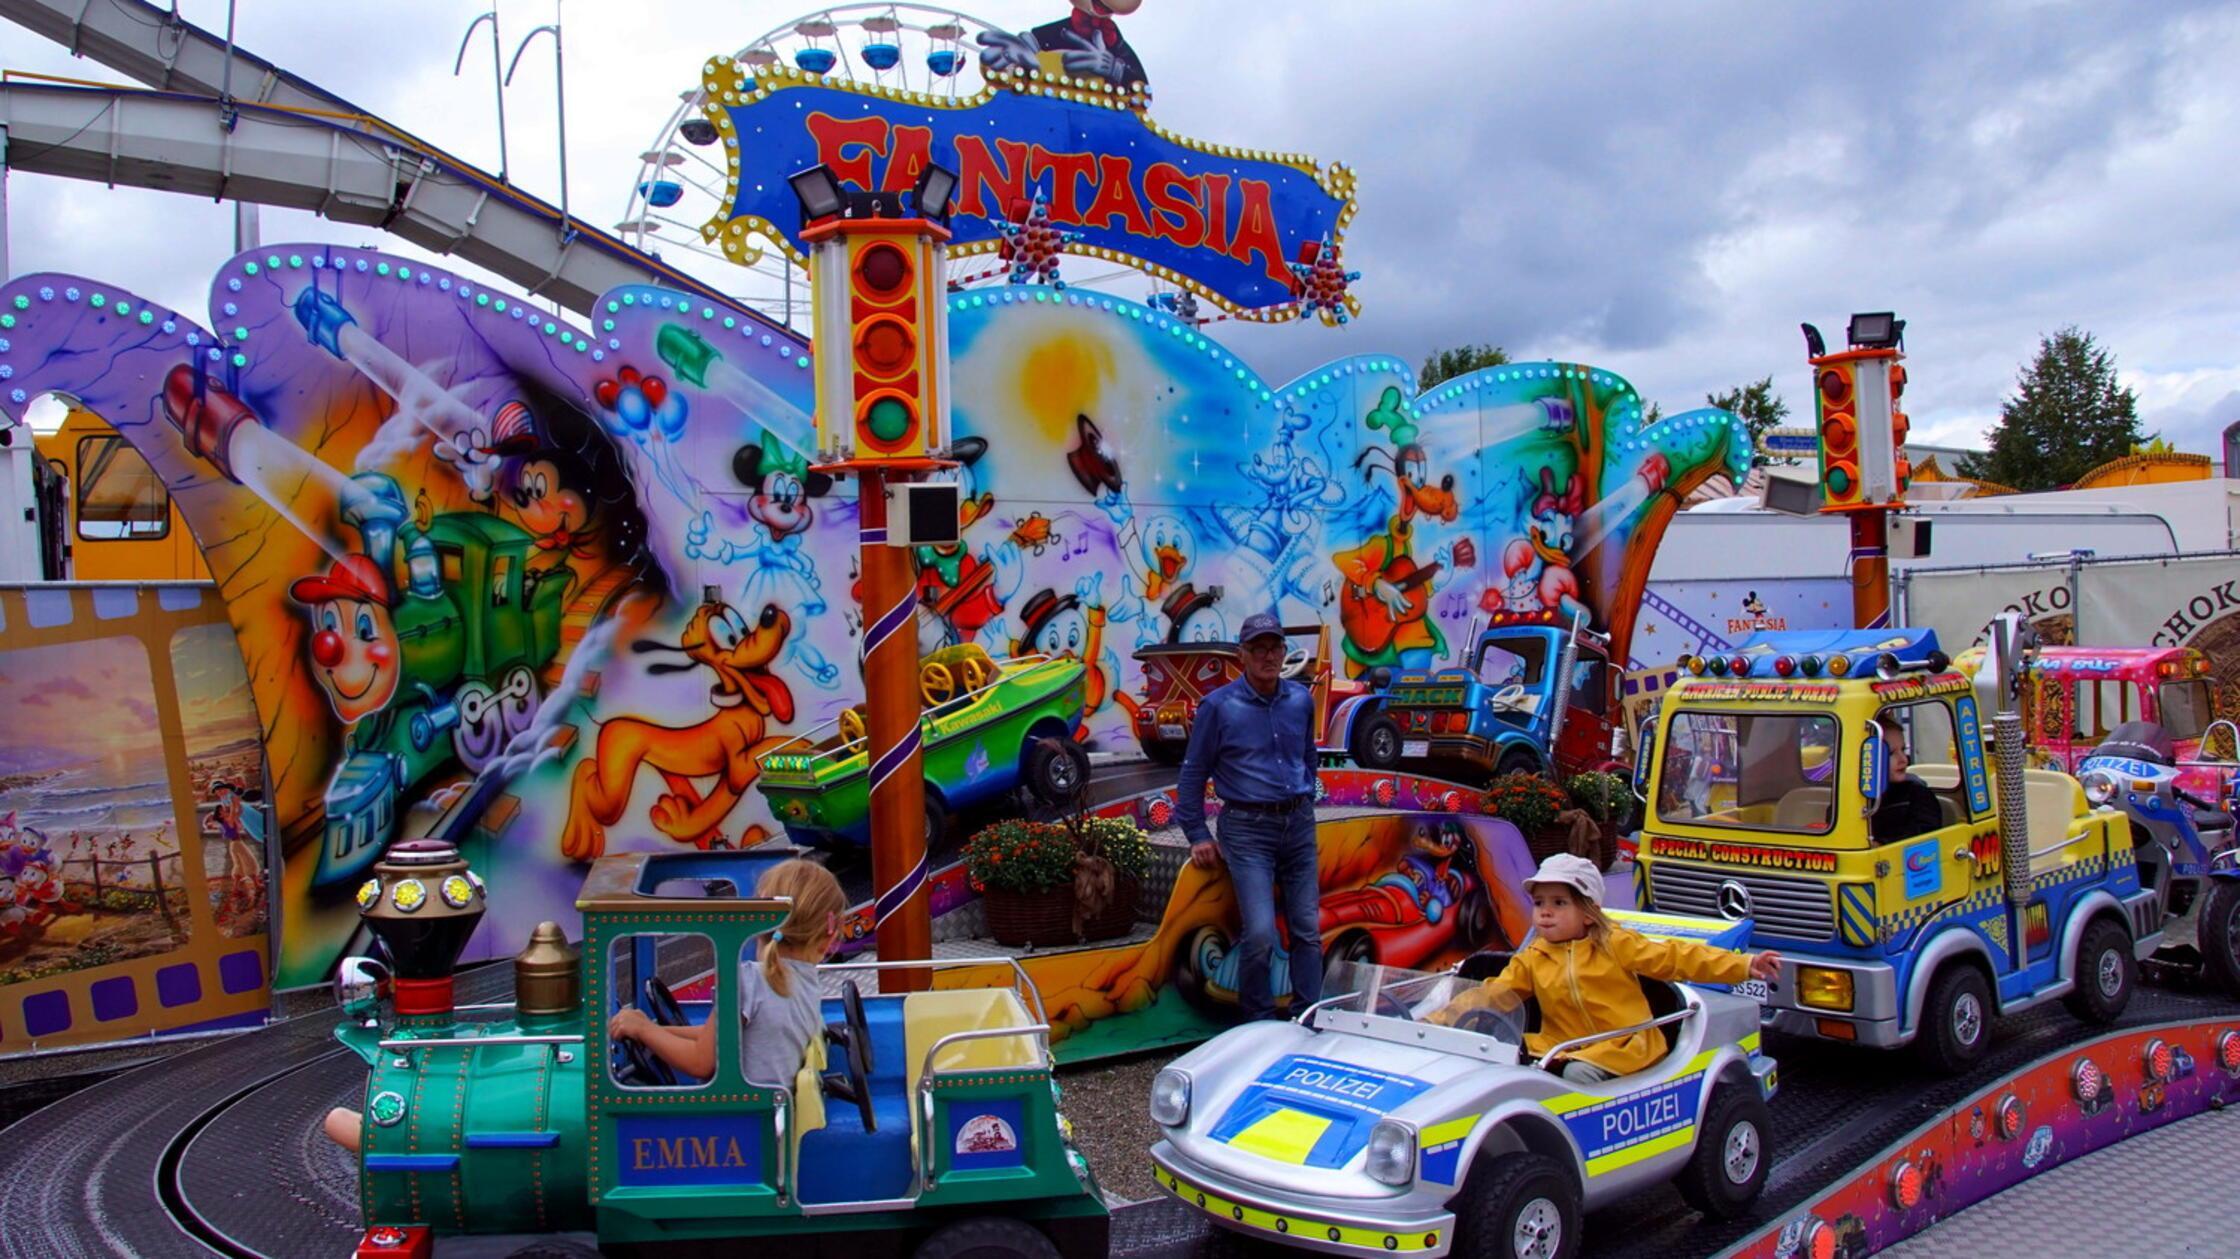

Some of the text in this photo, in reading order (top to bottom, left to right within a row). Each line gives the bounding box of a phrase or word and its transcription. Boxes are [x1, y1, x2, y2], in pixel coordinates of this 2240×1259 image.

[806, 111, 1296, 288] FANTASIA
[1742, 683, 1787, 700] PUBLIC
[1790, 684, 1839, 703] WORKS
[940, 700, 1002, 735] Kawasaki
[1863, 743, 1873, 791] DAKOTA
[1961, 705, 1986, 804] ACTROS
[1651, 837, 1837, 872] SPECIAL CONSTRUCTION
[1746, 982, 1766, 998] 522
[1284, 1067, 1384, 1100] POLIZEI
[1603, 1092, 1680, 1141] POLIZEI
[632, 1136, 748, 1170] EMMA
